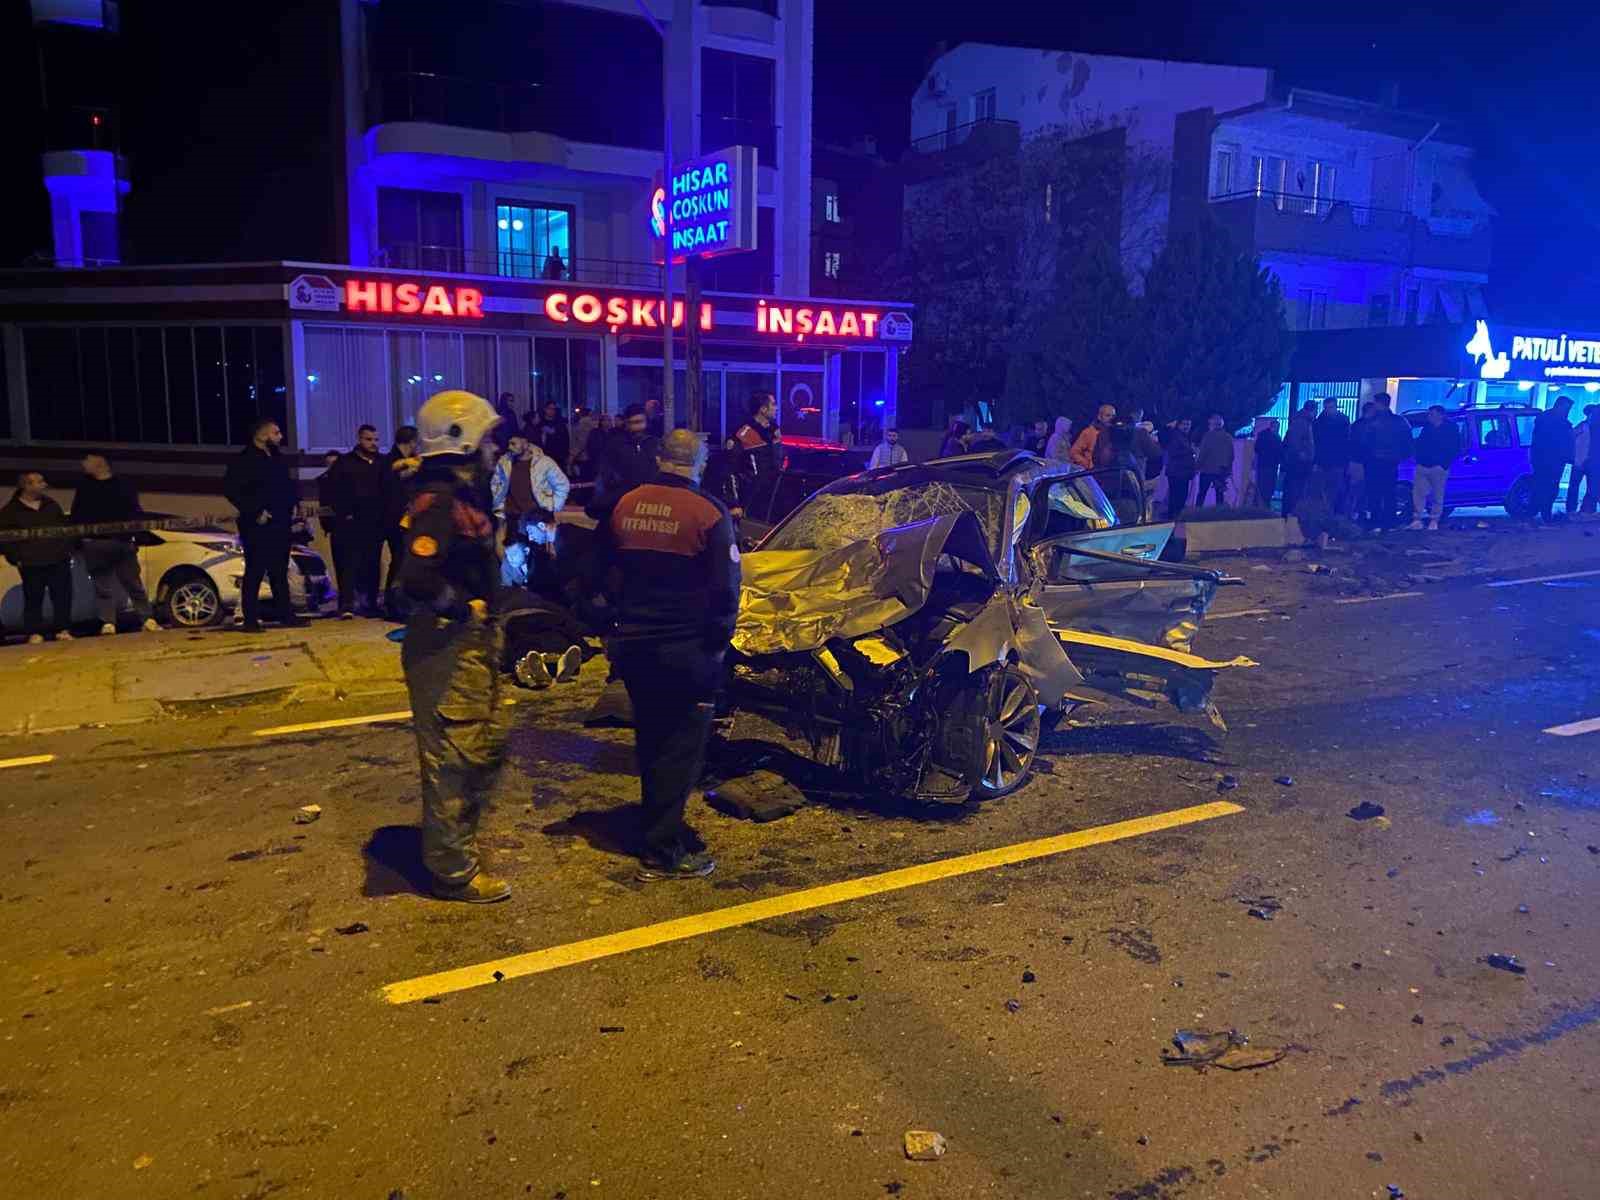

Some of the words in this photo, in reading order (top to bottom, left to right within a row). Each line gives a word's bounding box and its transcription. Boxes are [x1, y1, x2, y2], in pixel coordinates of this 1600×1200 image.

[673, 188, 728, 221] COŞKUN
[673, 220, 729, 250] İNŞAAT
[757, 299, 879, 342] İNŞAAT
[1512, 334, 1567, 362] PATULİ
